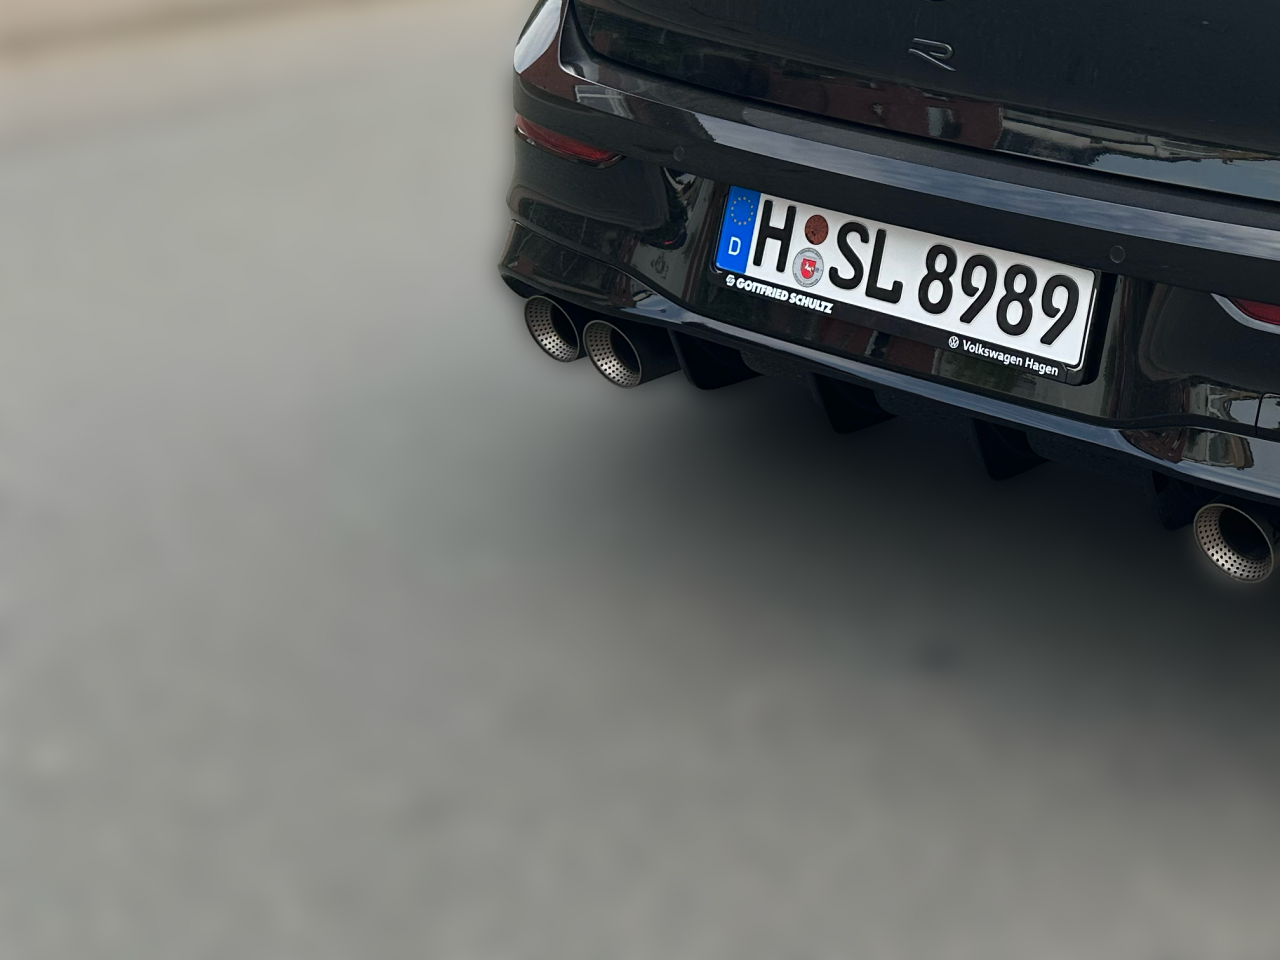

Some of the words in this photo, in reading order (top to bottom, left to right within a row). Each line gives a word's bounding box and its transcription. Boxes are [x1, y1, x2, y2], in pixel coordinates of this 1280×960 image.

[727, 236, 742, 257] D
[752, 199, 797, 273] H
[829, 222, 904, 304] SL
[918, 244, 1080, 346] 8989
[736, 277, 789, 302] GOTTFRIED
[788, 292, 834, 315] SCHULTZ
[962, 339, 1023, 366] Volkswagen
[1024, 356, 1059, 376] Hagen
